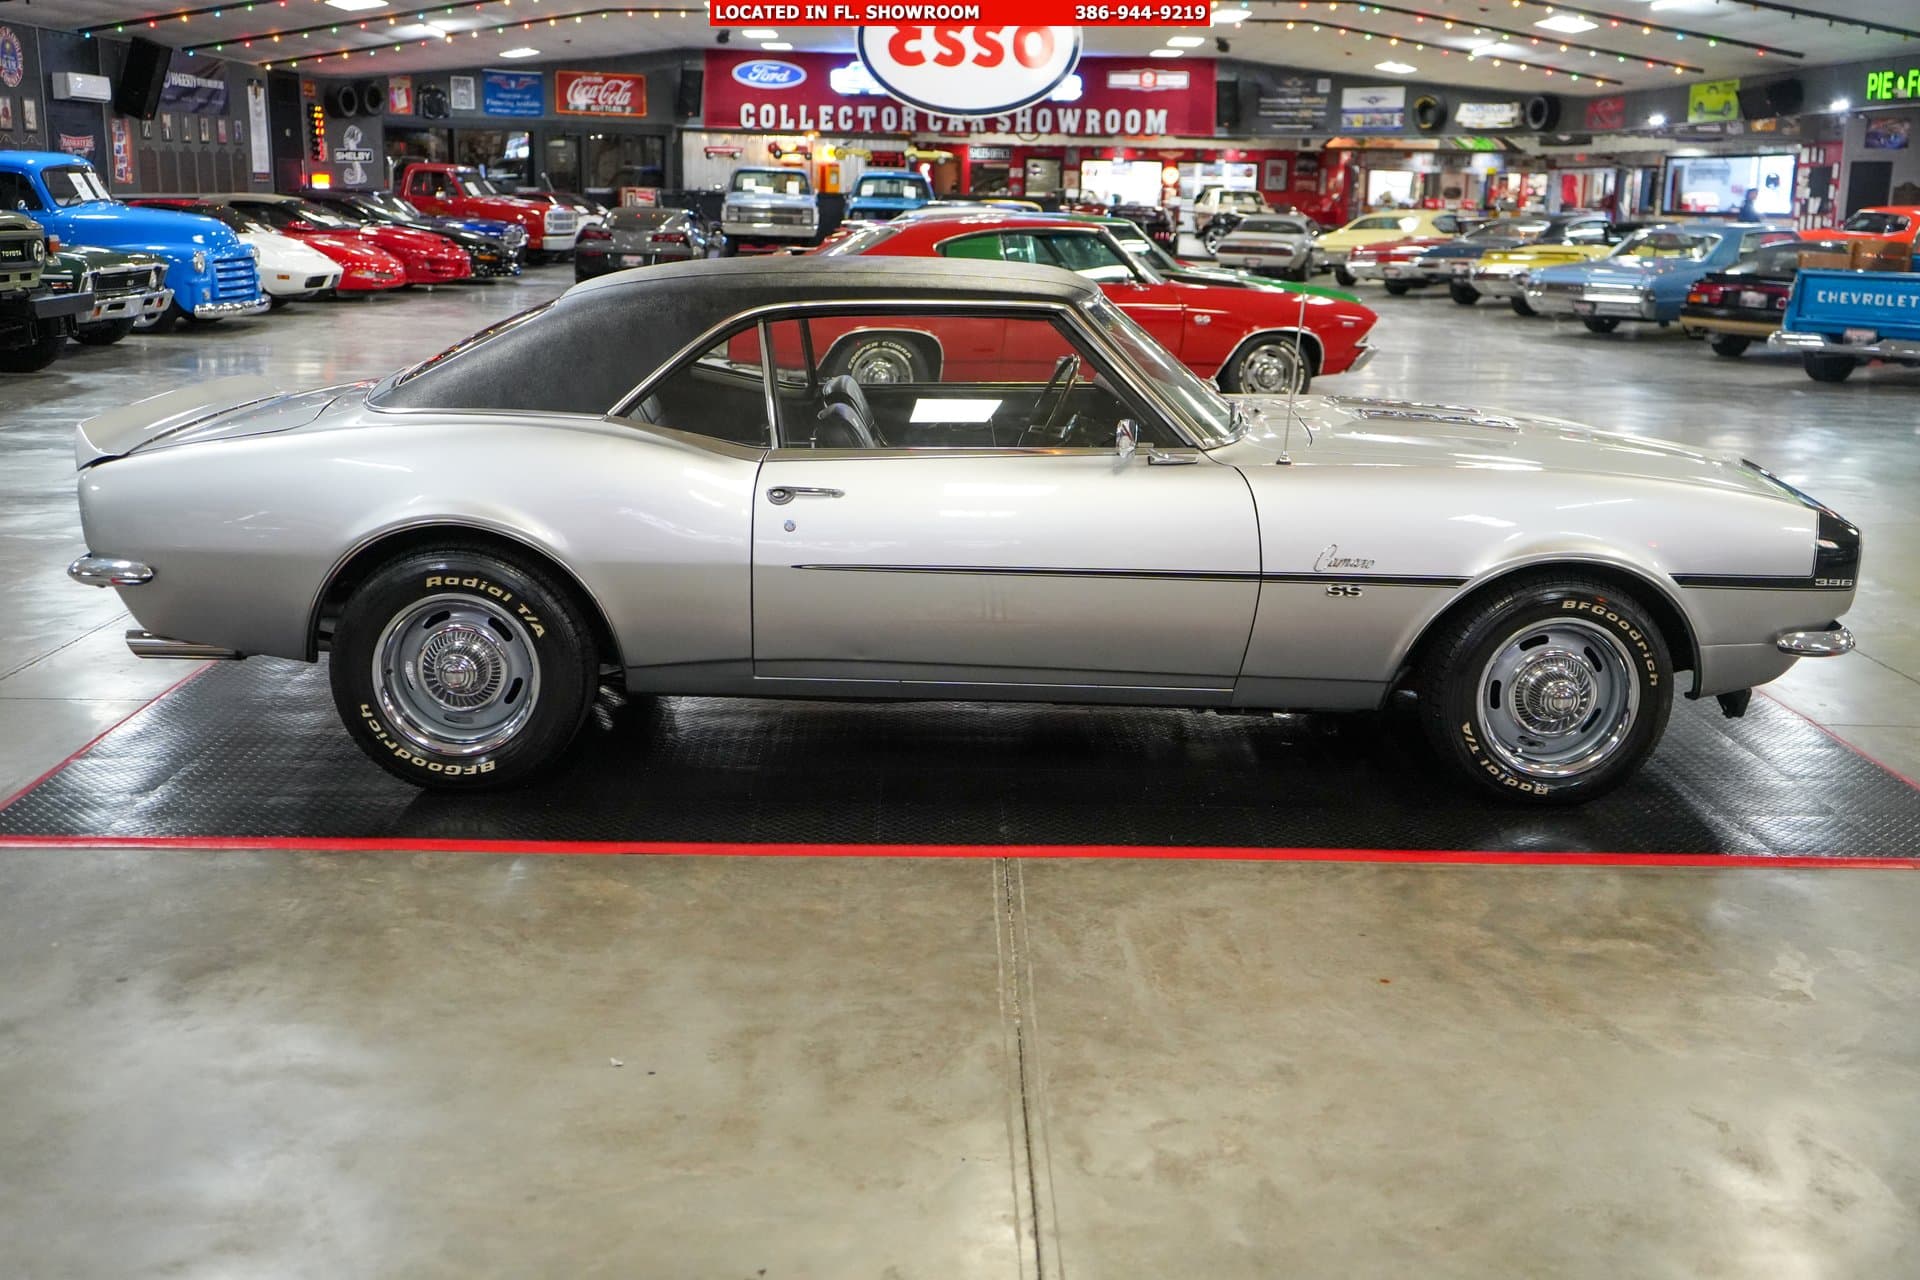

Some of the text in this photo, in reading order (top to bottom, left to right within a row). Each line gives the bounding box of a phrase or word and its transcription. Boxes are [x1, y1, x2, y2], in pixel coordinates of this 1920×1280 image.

[747, 64, 791, 83] Ford
[1867, 69, 1920, 100] PIE F
[740, 103, 917, 132] COLLECTOR
[996, 109, 1169, 135] SHOWROOM
[335, 151, 371, 161] SHELBY
[1817, 290, 1920, 309] CHEVROLET
[882, 341, 913, 359] COBRA
[1313, 543, 1376, 572] Camaro
[1325, 583, 1363, 598] SS
[426, 575, 546, 639] Radial T/A
[1562, 599, 1659, 688] BFGoodrich
[359, 703, 497, 776] BFGoodrich
[1479, 758, 1550, 797] Radial
